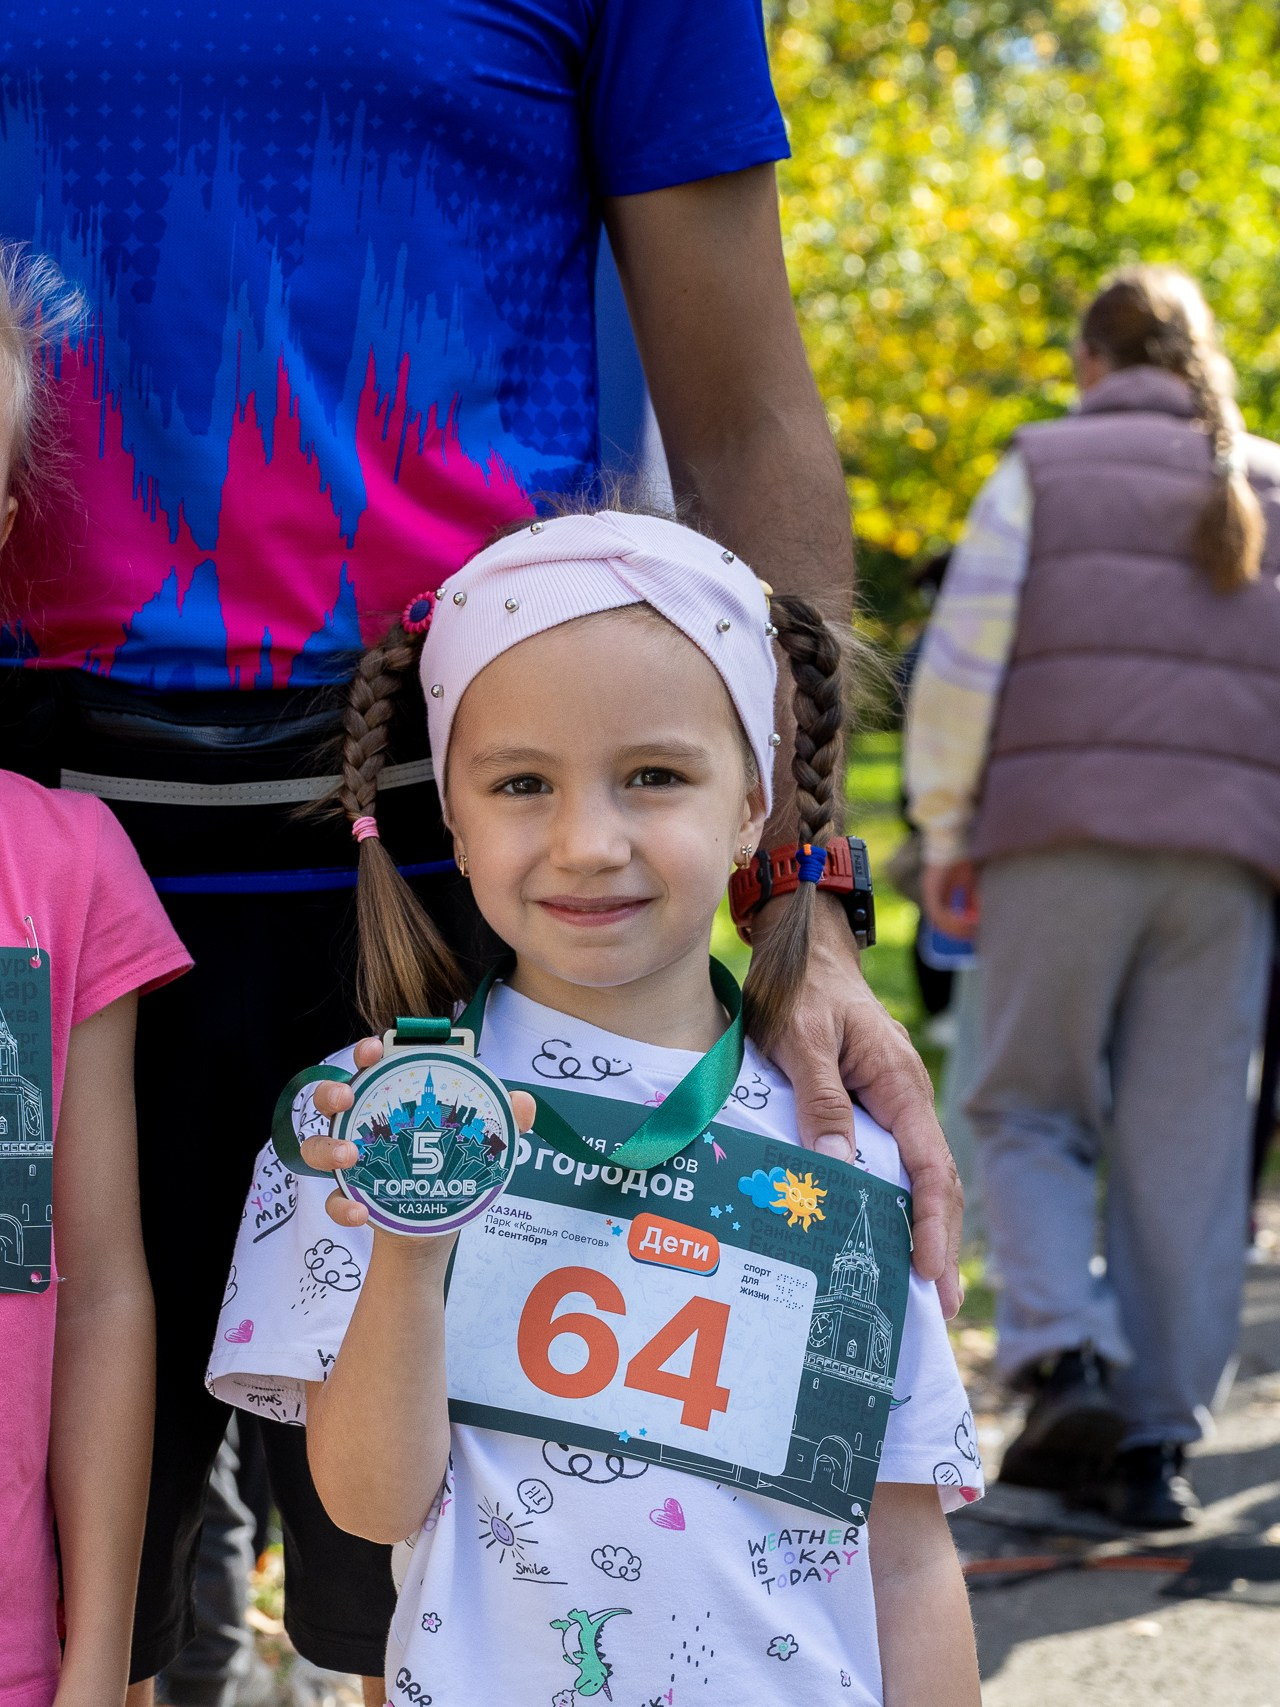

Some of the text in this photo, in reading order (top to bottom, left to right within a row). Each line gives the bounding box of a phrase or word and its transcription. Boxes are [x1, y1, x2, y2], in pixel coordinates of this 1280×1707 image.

[411, 1131, 445, 1175] 5
[373, 1179, 477, 1198] ГОРОДОВ
[535, 1147, 695, 1202] городов
[251, 1173, 296, 1211] YOUR
[398, 1203, 448, 1214] КАЗАНЬ
[483, 1225, 548, 1247] 14 сентября
[485, 1214, 610, 1248] Парк «Крылья Советов»
[639, 1226, 710, 1262] Дети
[741, 1275, 760, 1286] для
[743, 1263, 772, 1277] спорт
[739, 1286, 770, 1302] жизни
[517, 1265, 732, 1432] 64
[747, 1526, 860, 1558] WEATHER
[515, 1562, 551, 1576] Smile
[751, 1548, 859, 1578] IS OKAY
[761, 1566, 840, 1596] TODAY
